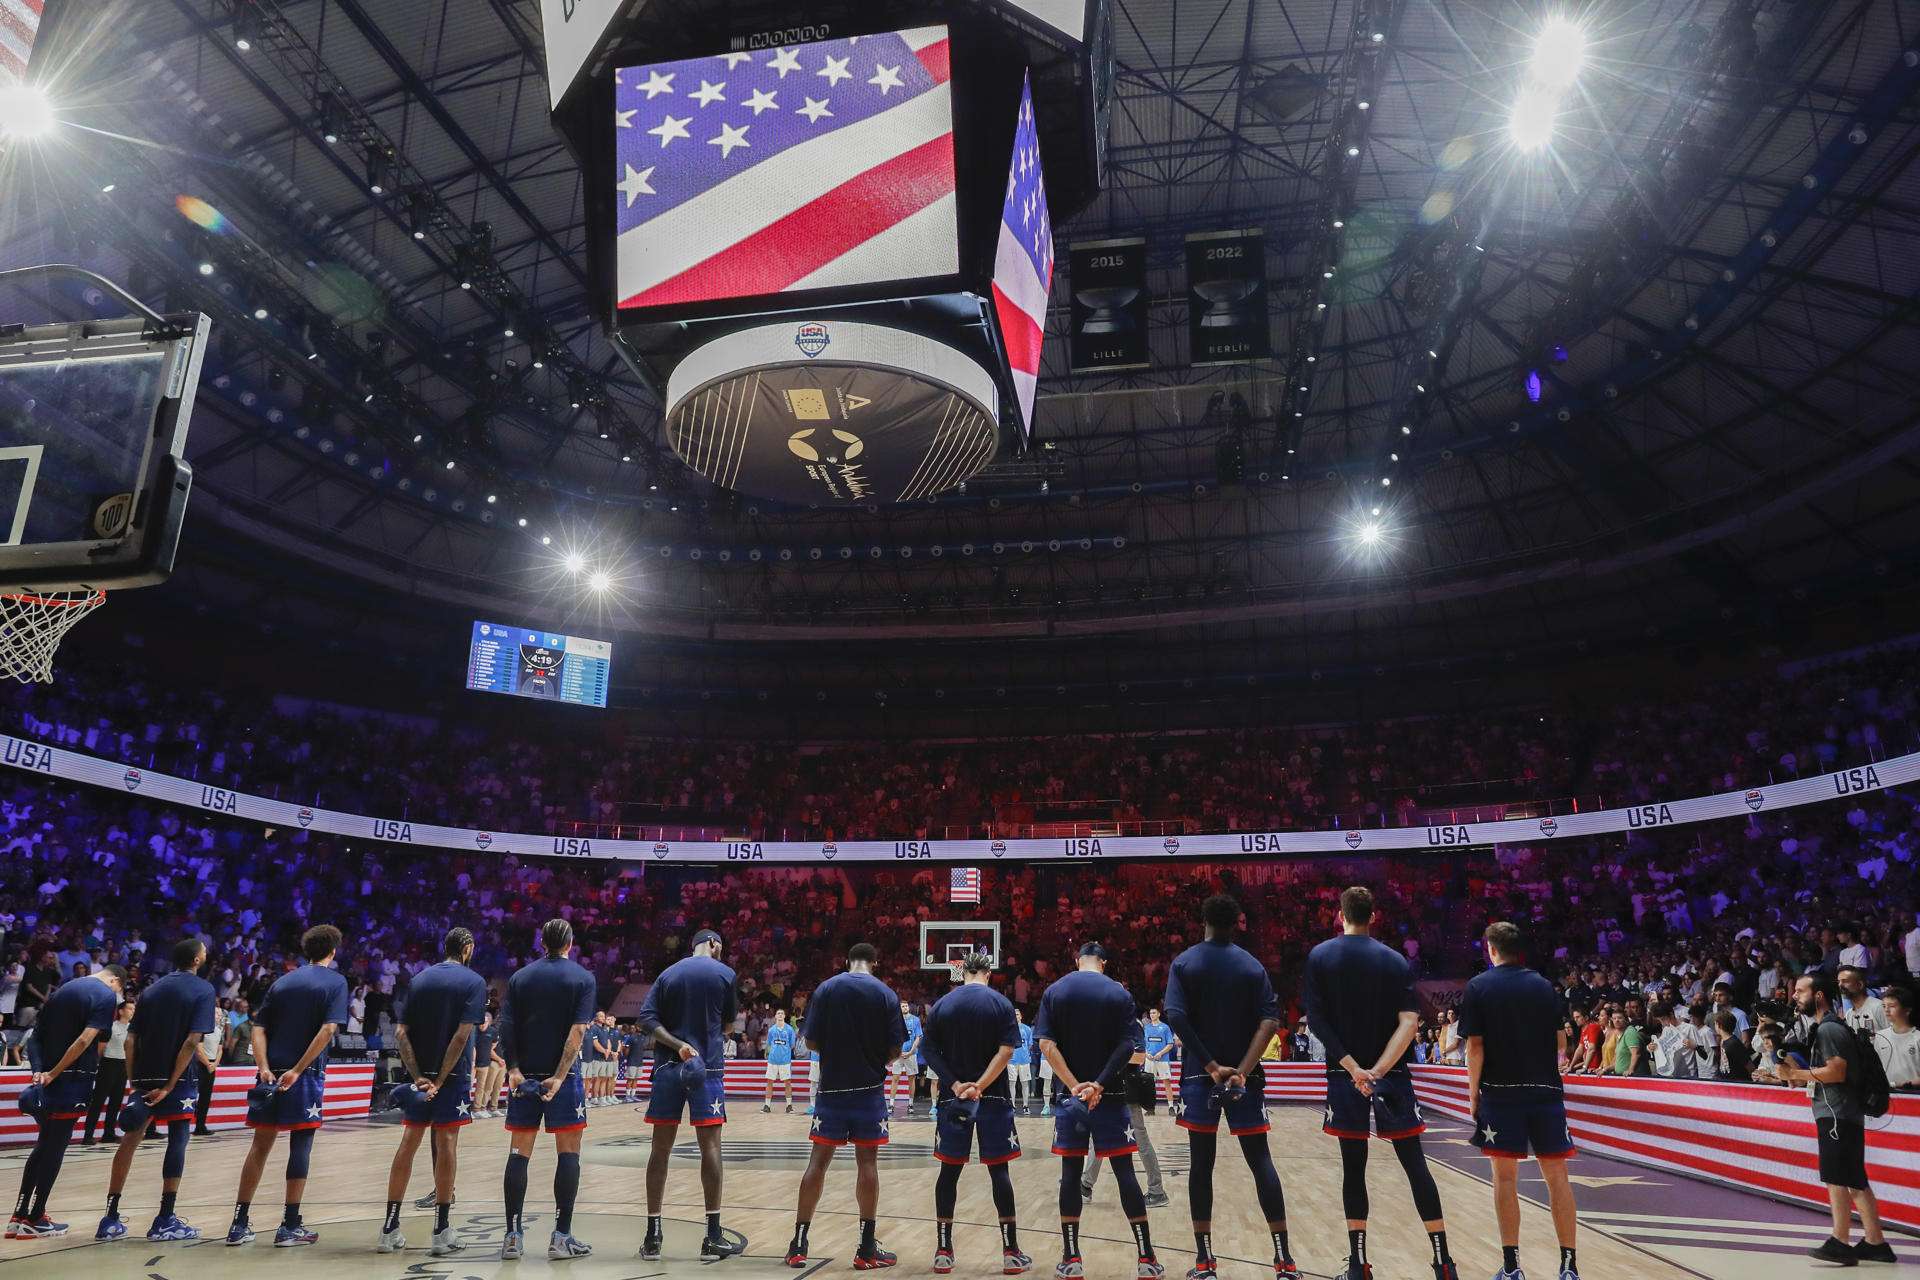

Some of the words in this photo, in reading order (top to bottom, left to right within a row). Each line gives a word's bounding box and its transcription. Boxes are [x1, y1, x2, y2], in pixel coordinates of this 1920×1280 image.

[749, 24, 830, 49] MONDO
[1090, 255, 1125, 268] 2015
[1206, 246, 1244, 260] 2022
[1093, 349, 1124, 359] LILLE
[531, 654, 552, 665] 4:19
[5, 738, 52, 772] USA
[1832, 766, 1882, 795] USA
[201, 785, 237, 813] USA
[1626, 803, 1674, 828] USA
[374, 820, 412, 842] USA
[1427, 826, 1471, 846] USA
[554, 838, 592, 857] USA
[727, 843, 764, 860] USA
[895, 842, 932, 859] USA
[1065, 838, 1103, 856] USA
[1241, 834, 1281, 853] USA
